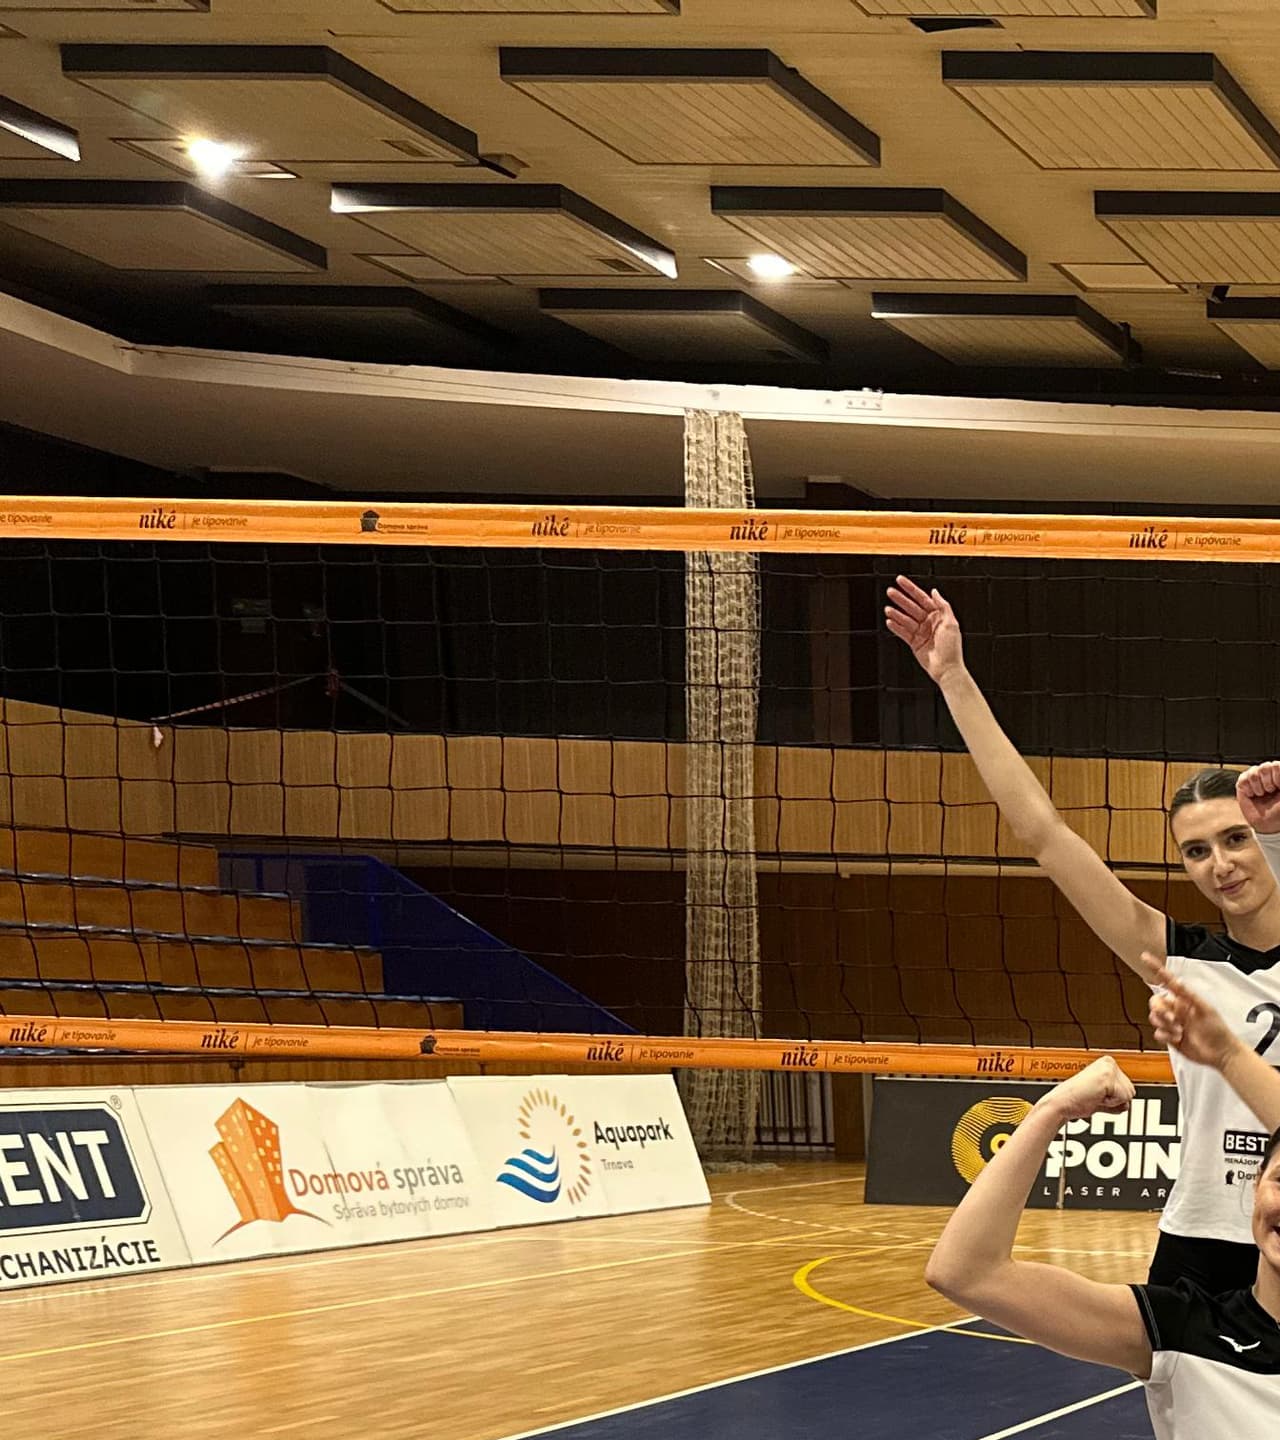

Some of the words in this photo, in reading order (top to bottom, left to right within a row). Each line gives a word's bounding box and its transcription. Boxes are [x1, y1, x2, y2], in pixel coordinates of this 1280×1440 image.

[139, 507, 176, 530] niké
[207, 516, 248, 528] tipovanie
[532, 514, 569, 537] niké
[596, 523, 640, 535] tipovanie
[730, 518, 768, 541] niké
[796, 527, 840, 540] tipovanie
[929, 523, 967, 545] niké
[995, 531, 1040, 543] tipovanie
[1129, 526, 1168, 549] niké
[1196, 534, 1241, 547] tipovanie
[9, 1022, 47, 1043] niké
[72, 1030, 116, 1042] tipovanie
[201, 1028, 239, 1050] niké
[264, 1036, 308, 1048] tipovanie
[587, 1040, 624, 1062] niké
[650, 1048, 694, 1060] tipovanie
[781, 1046, 818, 1067] niké
[844, 1054, 889, 1066] tipovanie
[977, 1052, 1015, 1073] niké
[594, 1117, 674, 1150] Aquapark
[1225, 1134, 1270, 1153] BEST
[0, 1130, 117, 1207] ENT
[1045, 1139, 1182, 1181] POIN
[288, 1162, 390, 1197] Domová
[393, 1160, 463, 1196] správa
[1043, 1186, 1120, 1198] LASER
[333, 1202, 377, 1222] Správa
[0, 1237, 160, 1281] CHANIZÁCIE
